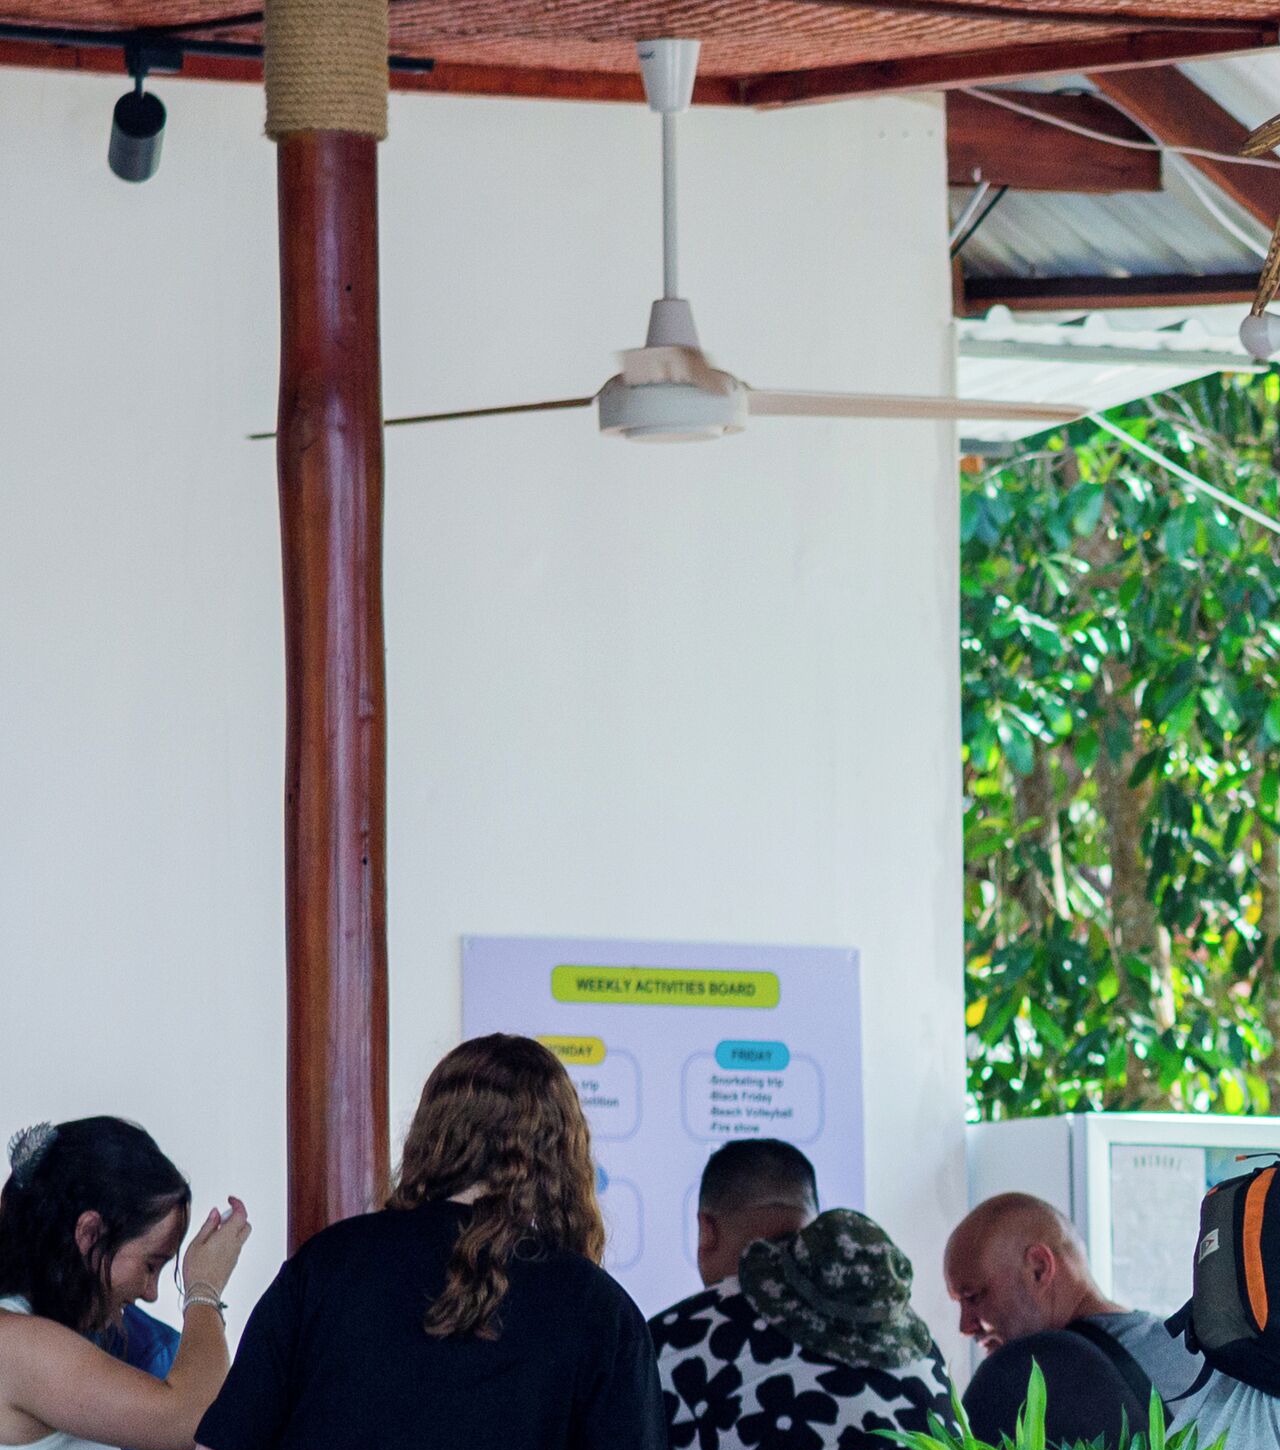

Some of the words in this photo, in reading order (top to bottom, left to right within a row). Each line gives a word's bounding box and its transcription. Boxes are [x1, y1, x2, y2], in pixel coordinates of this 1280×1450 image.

[576, 977, 631, 993] WEEKLY
[635, 979, 705, 995] ACTIVITIES
[709, 982, 756, 997] BOARD
[732, 1048, 772, 1061] FRIDAY
